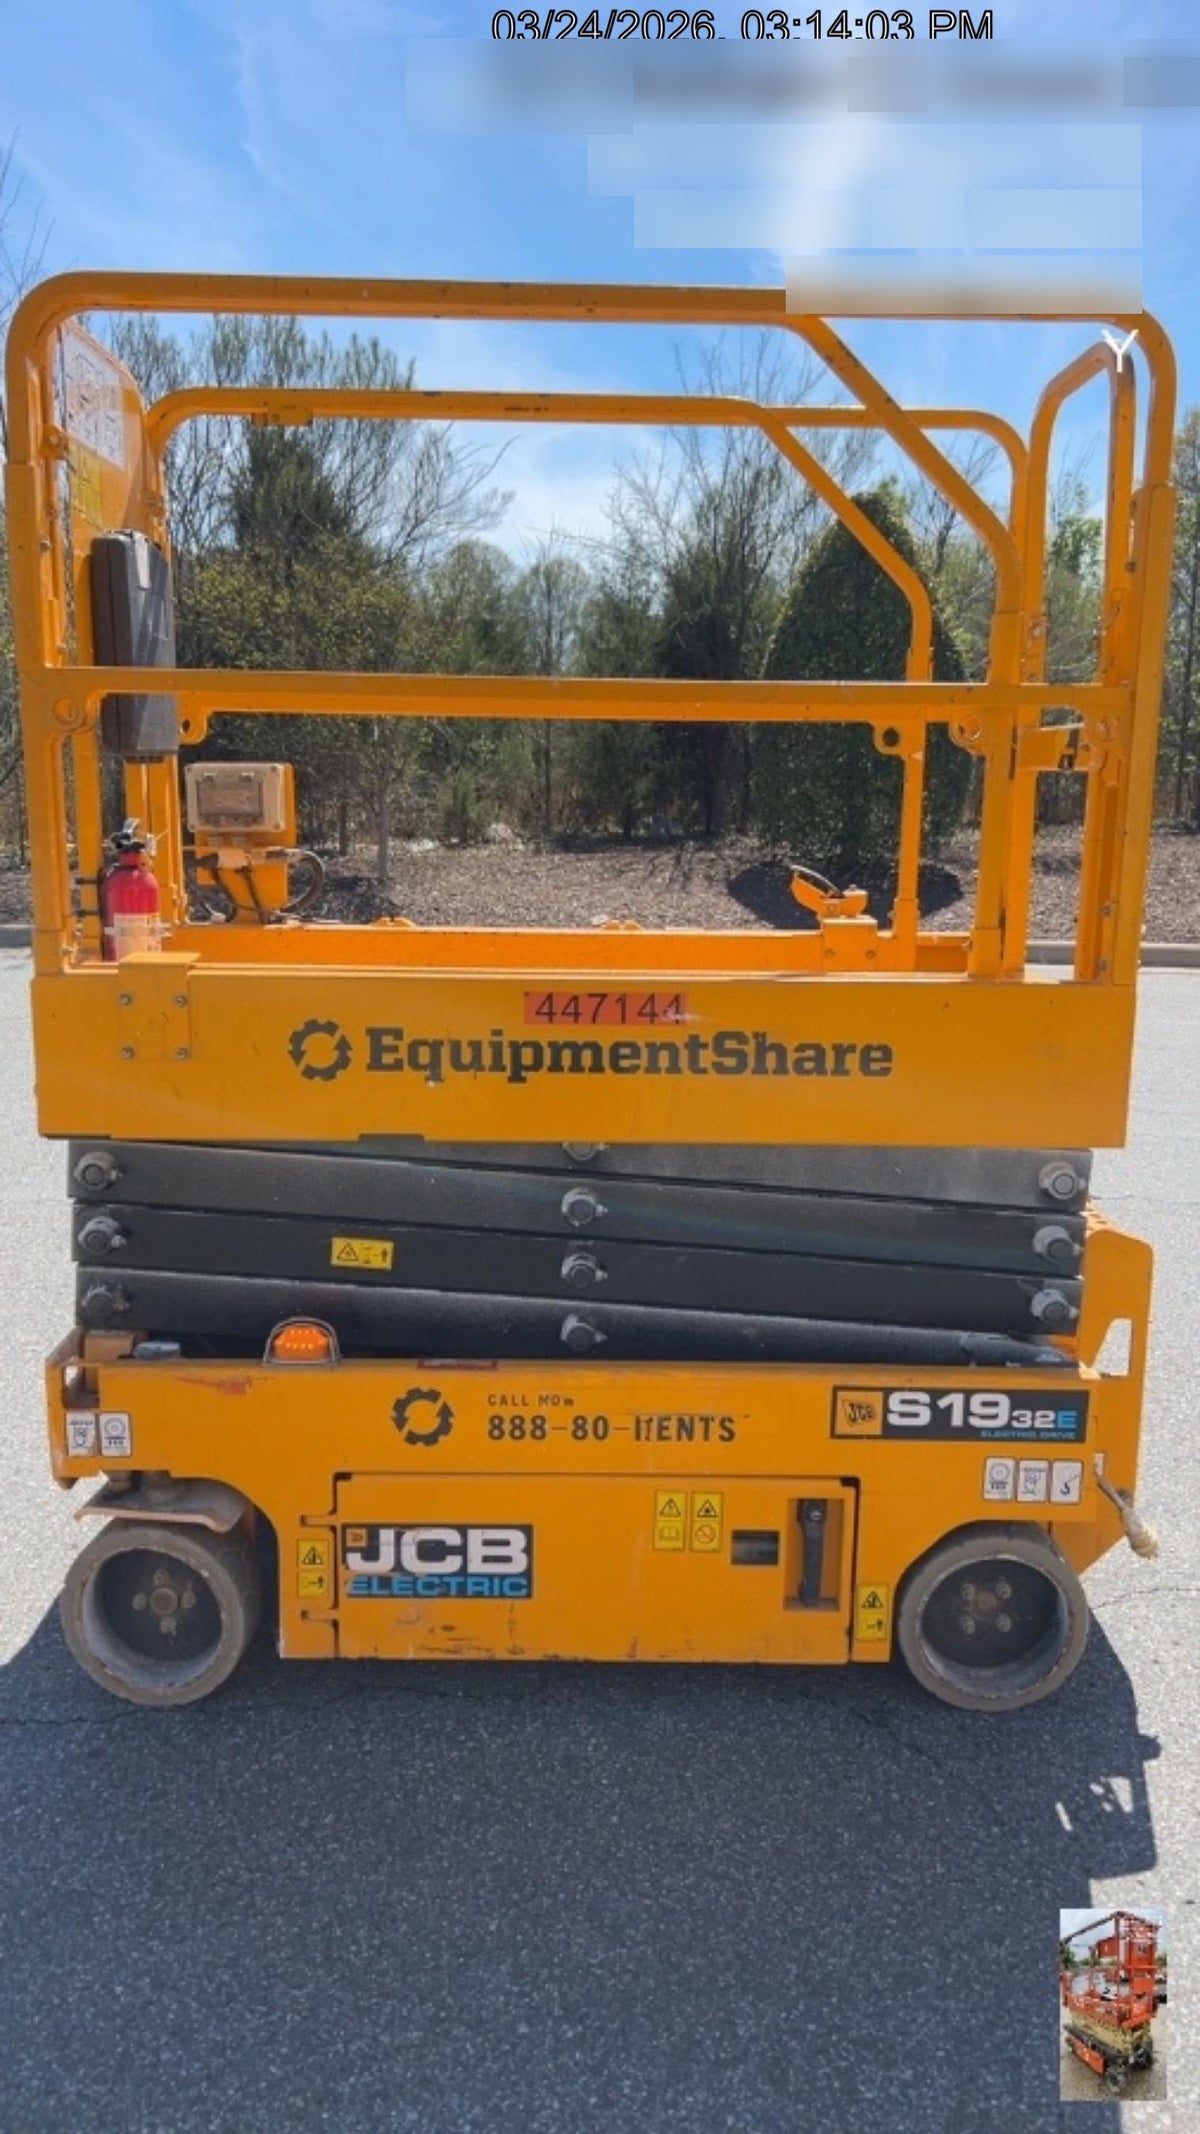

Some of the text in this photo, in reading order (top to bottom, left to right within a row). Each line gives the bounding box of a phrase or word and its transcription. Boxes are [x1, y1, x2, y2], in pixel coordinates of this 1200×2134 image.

[535, 992, 682, 1024] 447144
[365, 1027, 893, 1083] EquipmentShare
[487, 1393, 529, 1407] CALL
[345, 1528, 528, 1574] JCB
[347, 1575, 528, 1597] ELECTRIC
